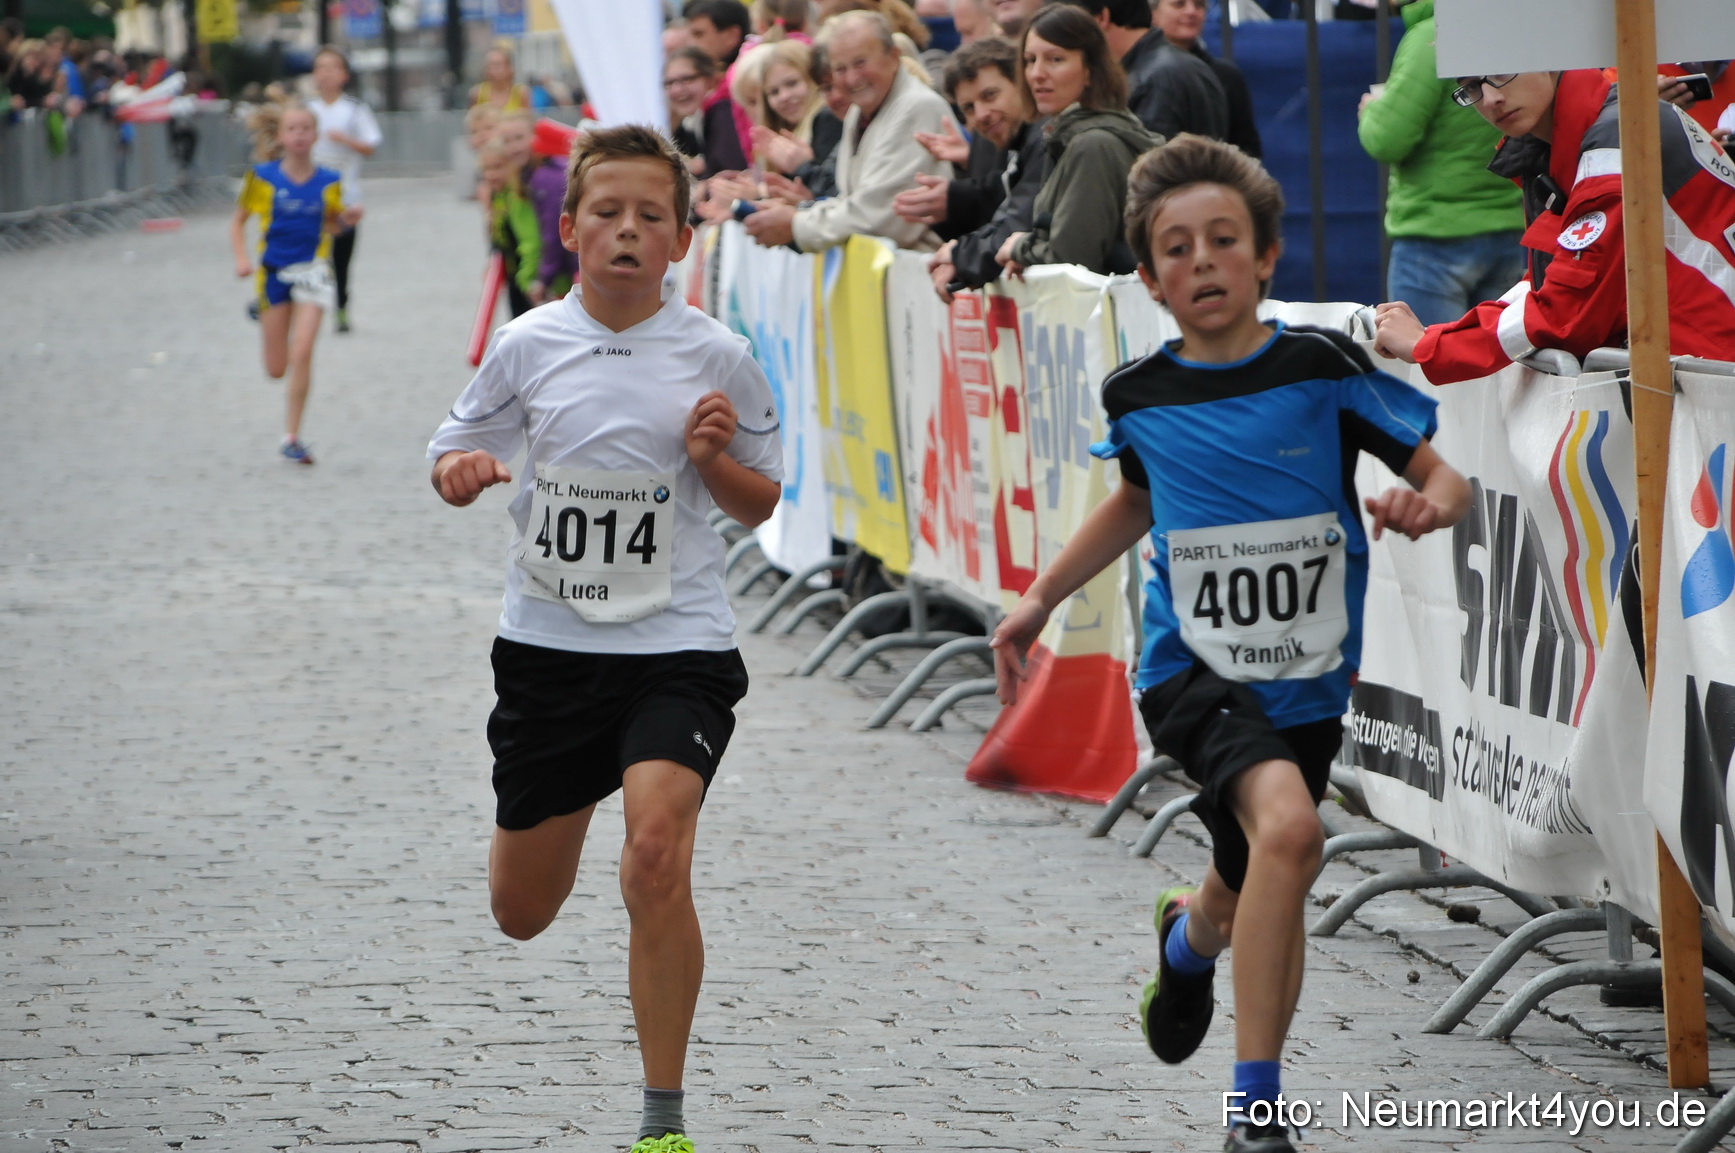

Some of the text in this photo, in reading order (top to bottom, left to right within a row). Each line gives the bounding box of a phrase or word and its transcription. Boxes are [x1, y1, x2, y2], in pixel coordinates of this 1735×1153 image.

[606, 348, 632, 357] JAKO
[568, 483, 647, 503] Neumarkt
[534, 505, 657, 565] 4014
[1172, 544, 1229, 562] PARTL
[1233, 535, 1319, 560] Neumarkt
[558, 577, 609, 601] Luca
[1193, 554, 1329, 629] 4007
[1227, 637, 1305, 664] Yannik
